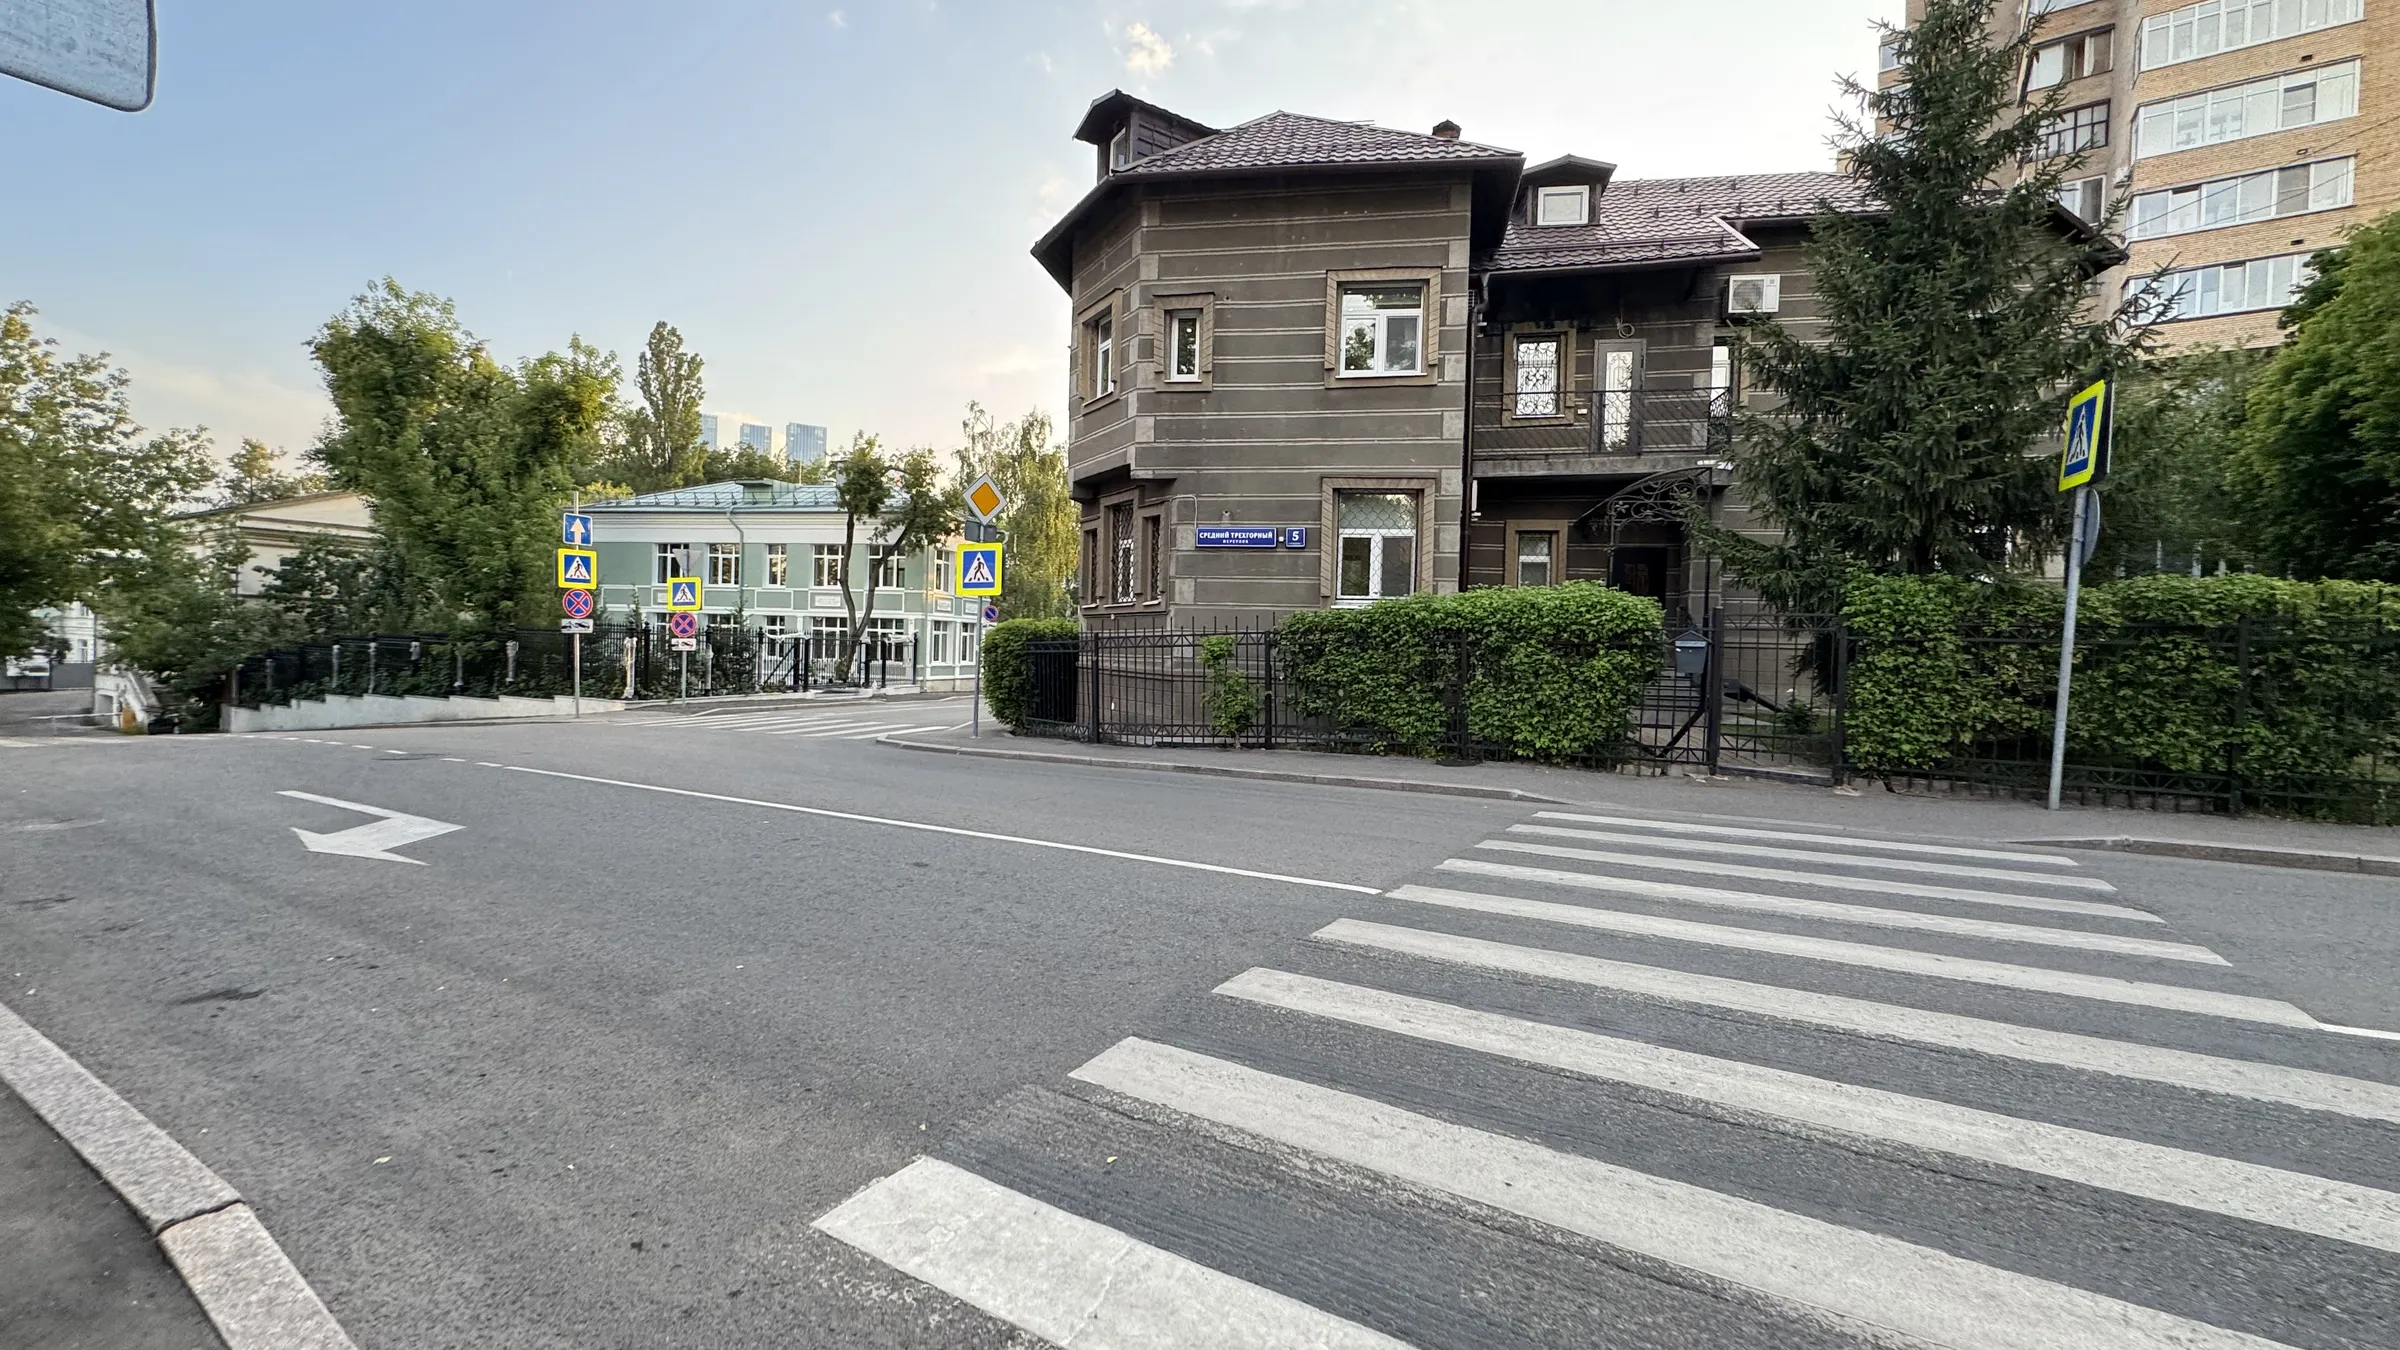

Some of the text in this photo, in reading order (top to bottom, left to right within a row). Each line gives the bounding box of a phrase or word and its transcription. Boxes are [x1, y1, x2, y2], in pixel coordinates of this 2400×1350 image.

[1199, 531, 1273, 539] СРЕДНИЙ ТРЕХГОРНЫЙ
[1292, 531, 1299, 541] 5
